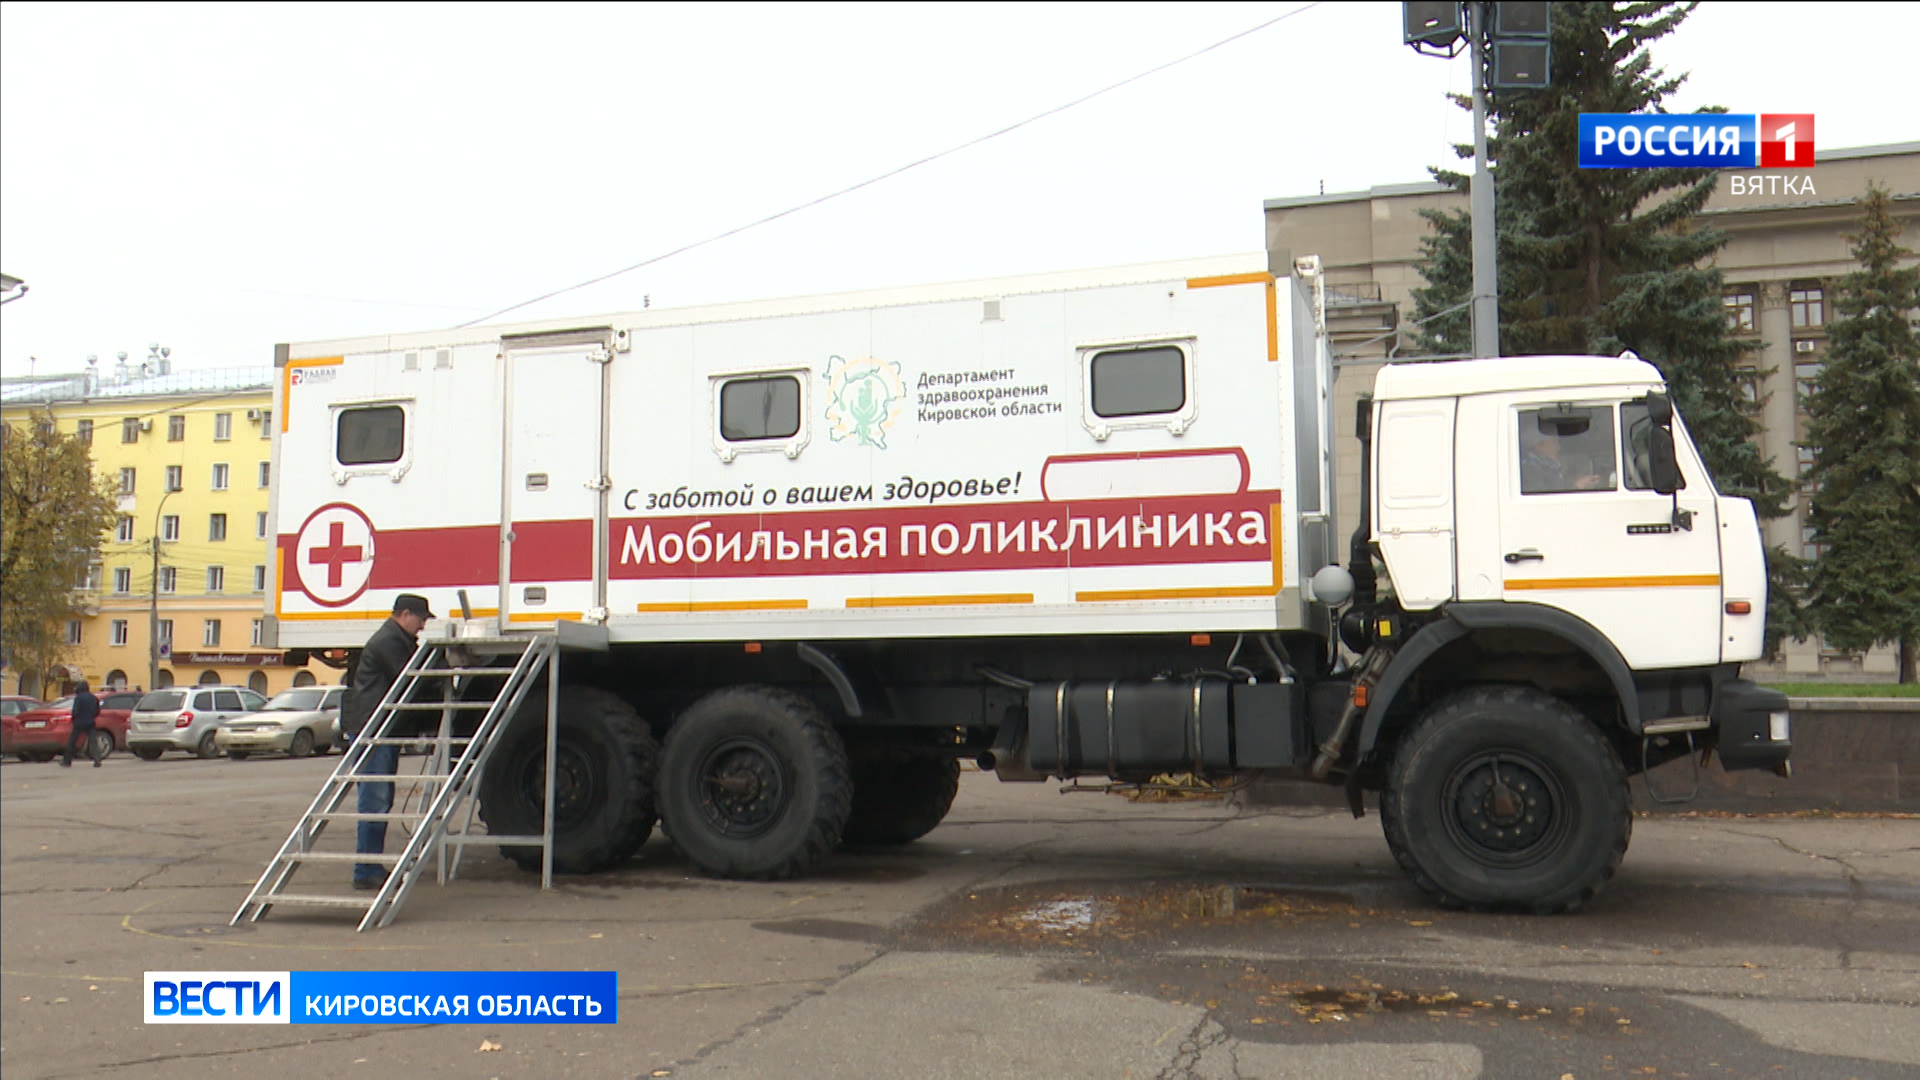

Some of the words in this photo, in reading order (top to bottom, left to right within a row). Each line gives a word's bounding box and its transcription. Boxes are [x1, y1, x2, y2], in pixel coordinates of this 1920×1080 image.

[917, 368, 1015, 389] Департамент
[917, 383, 1049, 407] здравоохранения
[917, 403, 997, 424] Кировской
[1001, 402, 1062, 417] области
[624, 489, 639, 510] С
[645, 483, 754, 510] заботой
[762, 488, 777, 506] о
[785, 484, 873, 505] вашем
[882, 471, 1022, 503] здоровье!
[620, 521, 887, 564] Мобильная
[901, 510, 1267, 556] поликлиника
